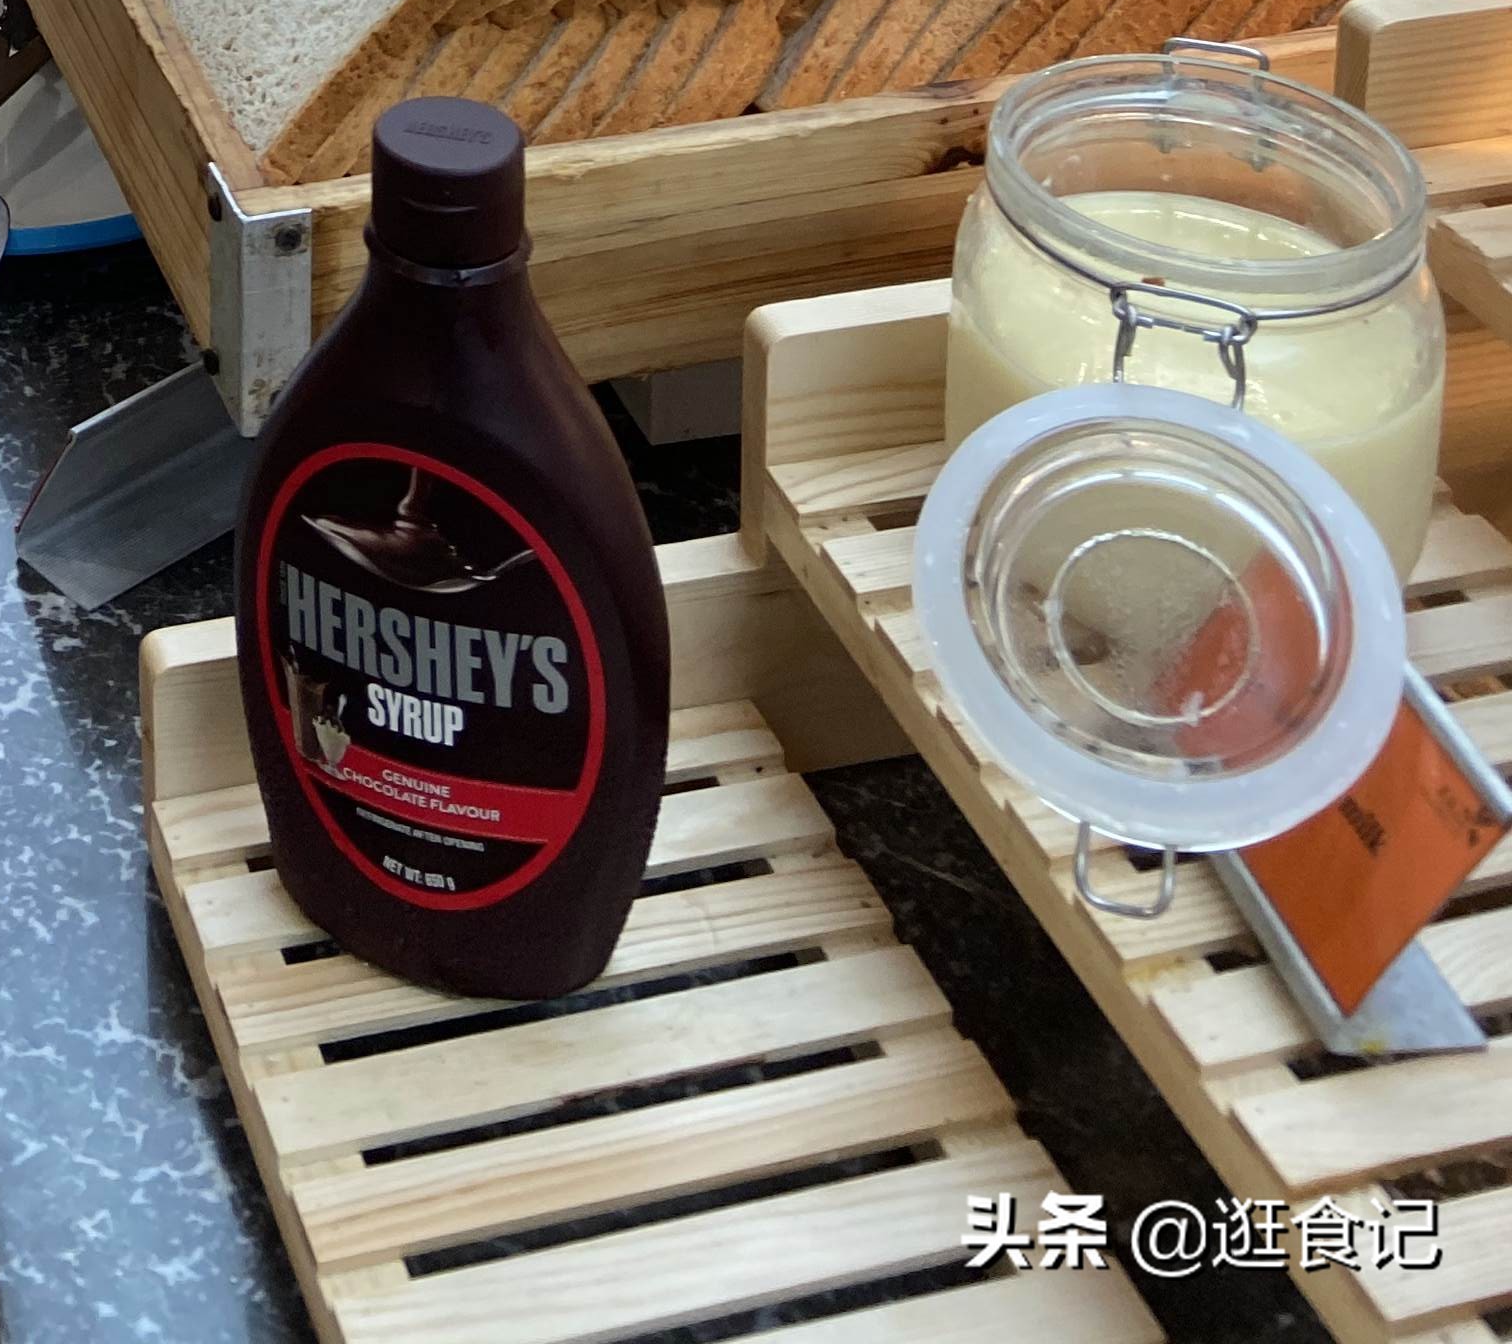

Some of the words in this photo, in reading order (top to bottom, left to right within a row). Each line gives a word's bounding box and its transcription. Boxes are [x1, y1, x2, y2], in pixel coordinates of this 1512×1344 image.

[288, 564, 569, 714] HERSHEY'S
[367, 683, 464, 746] SYRUP
[343, 767, 427, 808] CHOCOLATE
[429, 798, 501, 822] FLAVOUR
[382, 769, 451, 798] GENUINE
[382, 855, 403, 876] NET
